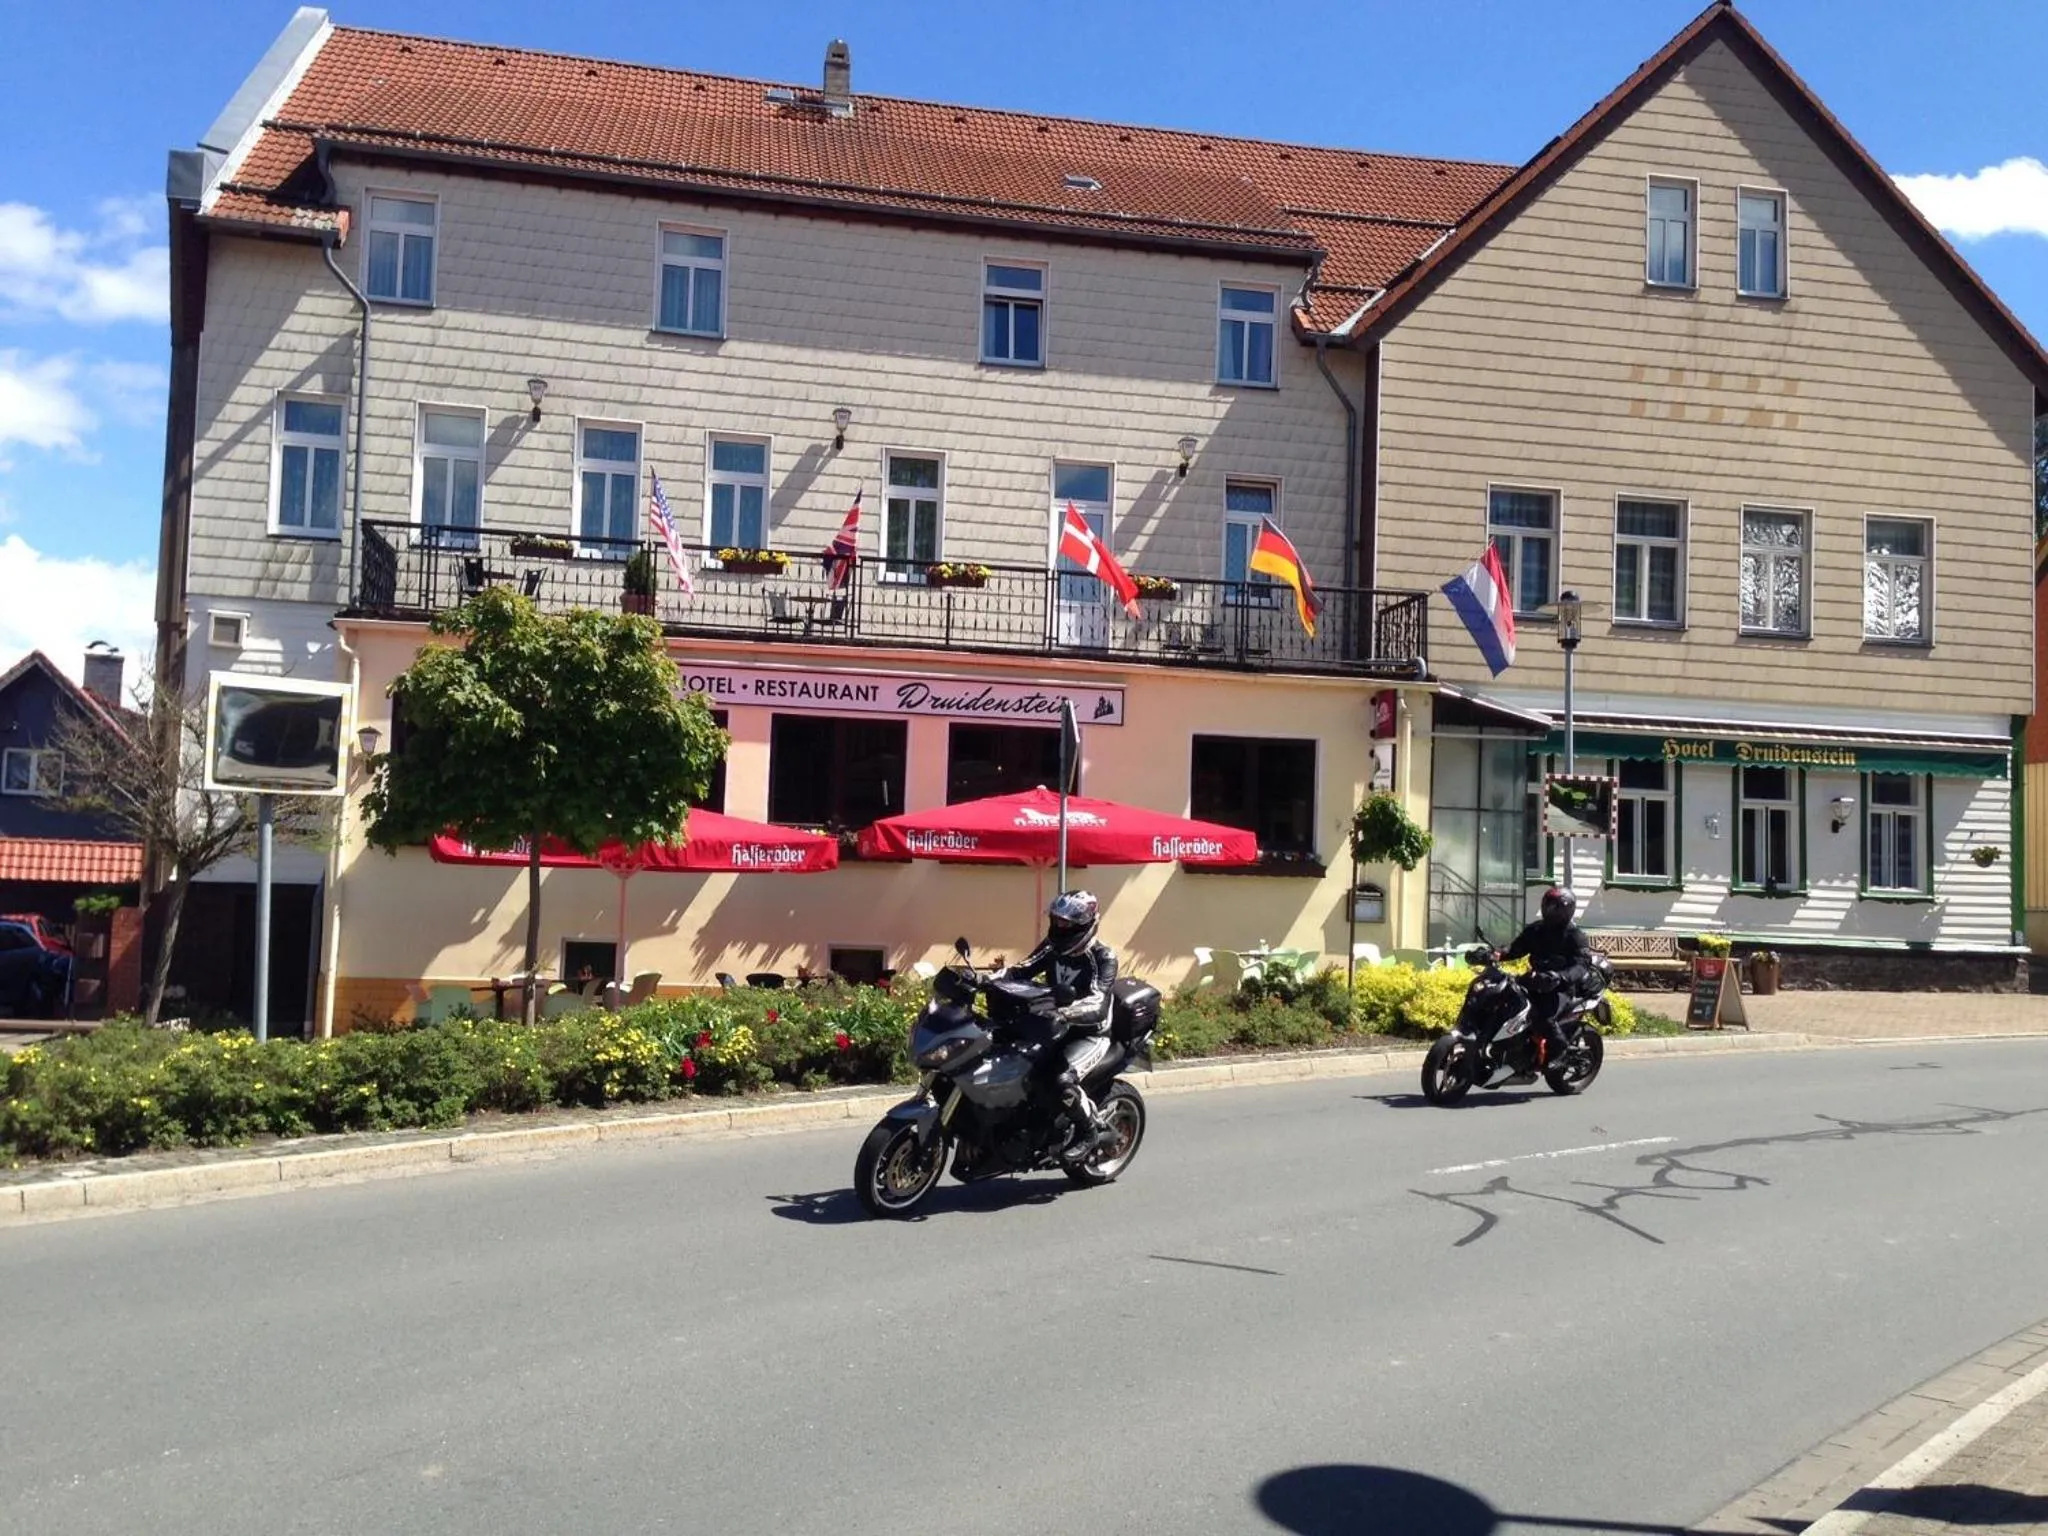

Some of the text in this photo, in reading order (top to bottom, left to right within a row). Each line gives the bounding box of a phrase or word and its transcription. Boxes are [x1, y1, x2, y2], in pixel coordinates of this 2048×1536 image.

[754, 679, 880, 702] RESTAURANT
[896, 682, 1080, 715] Druidenstei
[1661, 739, 1856, 766] Hotel Druidenstein
